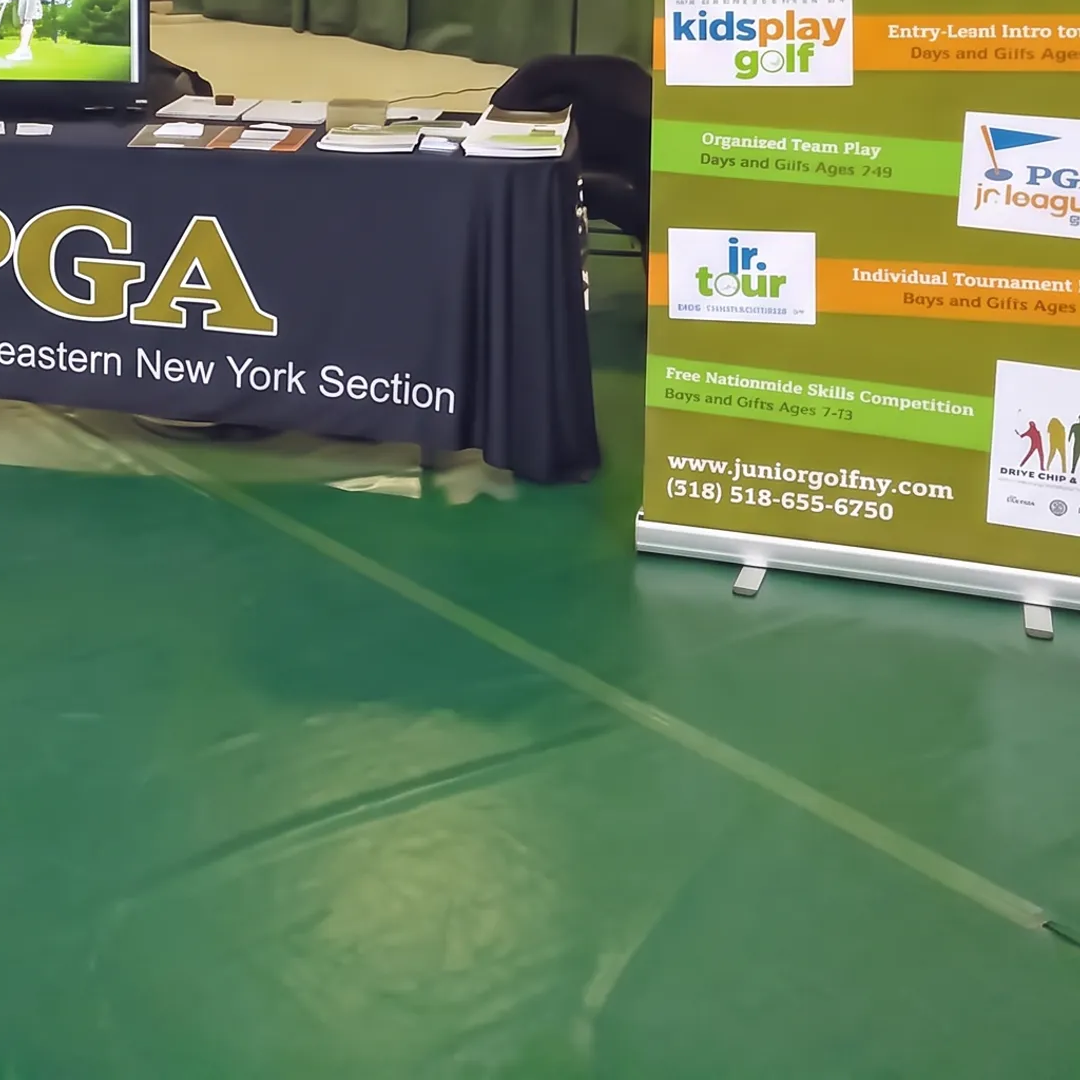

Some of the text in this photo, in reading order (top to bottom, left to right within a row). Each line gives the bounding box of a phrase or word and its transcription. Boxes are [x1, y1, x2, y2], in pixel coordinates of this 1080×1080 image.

[673, 10, 846, 47] kidsplay
[1002, 24, 1052, 39] Intro
[734, 42, 815, 80] golf
[911, 46, 950, 63] Days
[956, 47, 988, 60] and
[700, 153, 736, 169] Days
[740, 157, 770, 170] and
[790, 138, 839, 154] Team
[843, 142, 882, 160] Play
[1026, 165, 1080, 189] PG
[728, 237, 767, 276] jr.
[695, 266, 787, 298] tour
[852, 267, 1073, 293] Individual Tournament
[949, 296, 982, 309] and
[1034, 299, 1077, 316] Ages
[135, 347, 215, 385] New
[226, 355, 307, 395] York
[318, 366, 456, 414] Section
[666, 366, 701, 383] Free
[807, 383, 855, 402] Skills
[860, 390, 975, 417] Competition
[705, 395, 733, 407] and
[779, 402, 817, 417] Ages
[667, 455, 954, 500] www.juniorgolfny.com
[1038, 472, 1067, 483] CHIP
[730, 485, 894, 521] 518-655-6750
